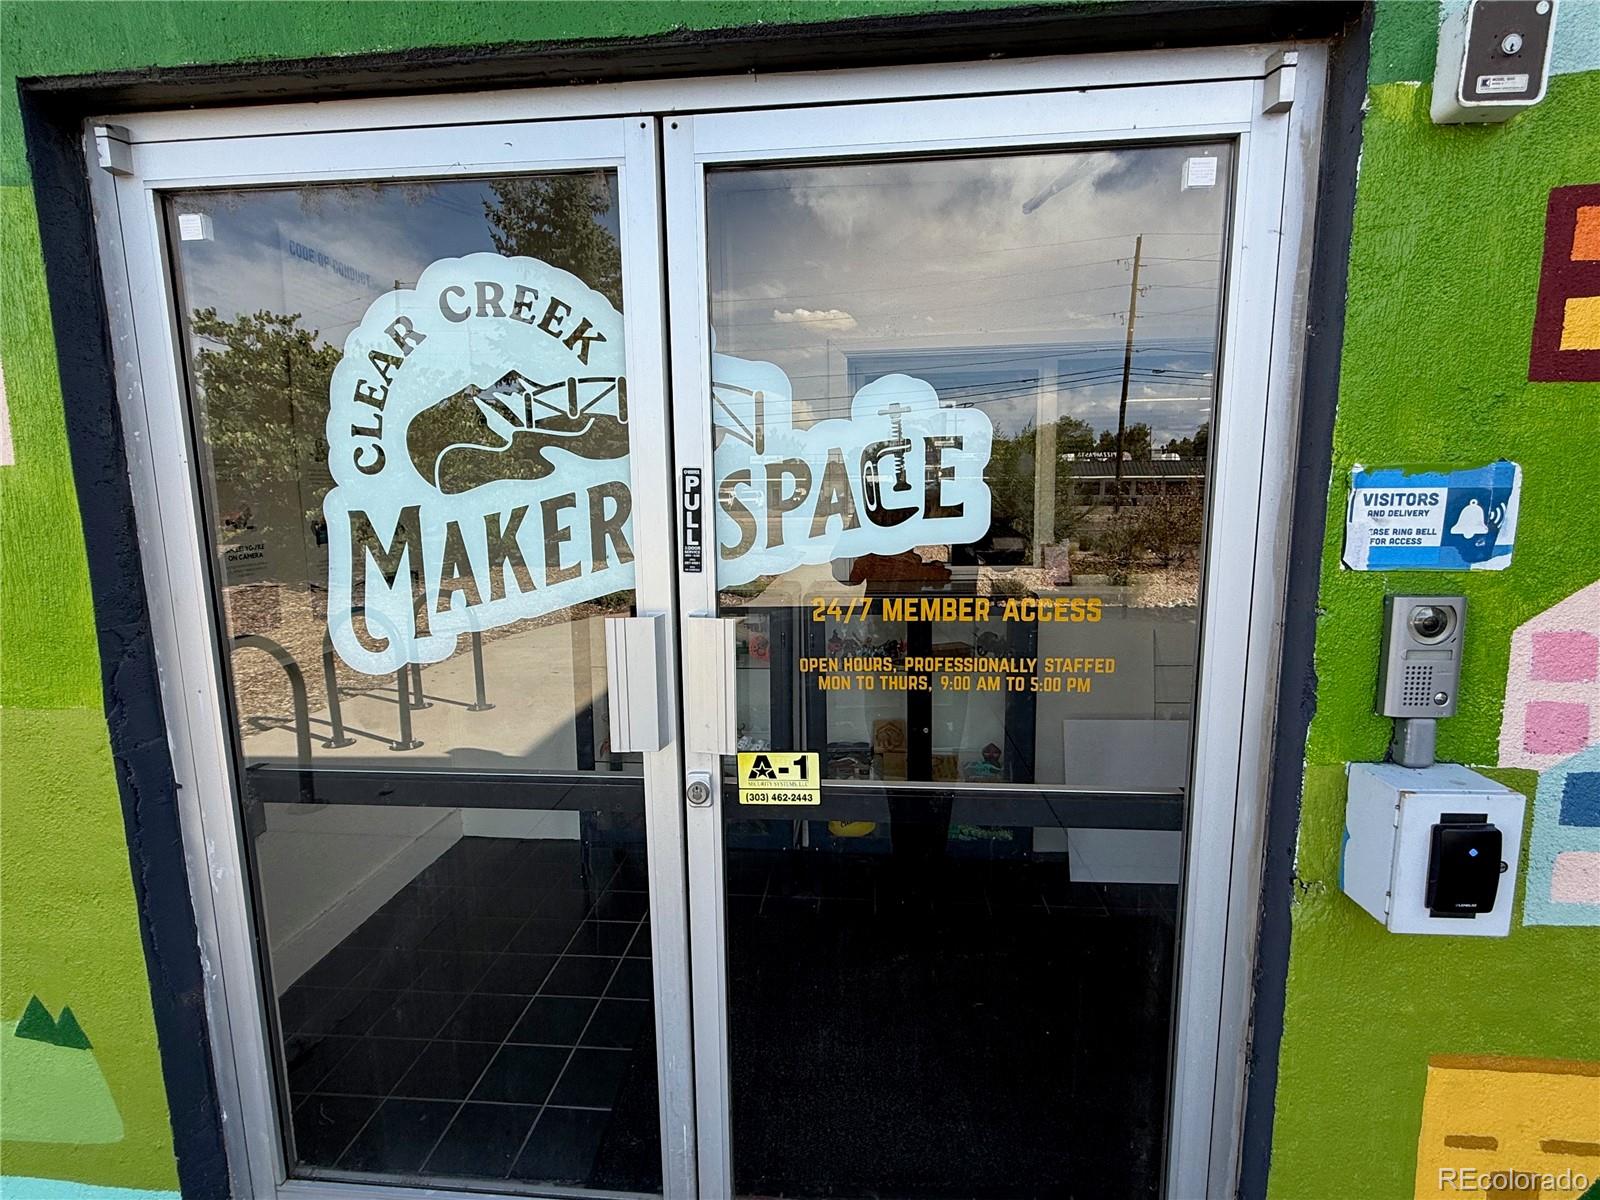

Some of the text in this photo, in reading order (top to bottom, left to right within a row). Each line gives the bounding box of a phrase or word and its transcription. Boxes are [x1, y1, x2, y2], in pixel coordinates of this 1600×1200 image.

[289, 240, 315, 263] CODE
[350, 281, 607, 476] CLEAR CREEK
[1363, 493, 1440, 506] VISITORS
[684, 475, 700, 546] PULL
[1387, 509, 1430, 517] DELIVERY
[348, 403, 964, 653] MAKER SPACE
[1392, 528, 1413, 536] RING
[1415, 528, 1437, 536] BELL
[239, 552, 264, 561] CAMERA
[811, 597, 1102, 624] 24/7 MEMBER ACCESS
[799, 657, 1116, 673] OPEN HOURS, PROFESSIONALLY STAFFED
[818, 675, 1092, 693] MON TO THURS, 9:00 AM TO 5:00 PM
[748, 755, 809, 779] A-1
[746, 793, 813, 802] (303) 462-2443
